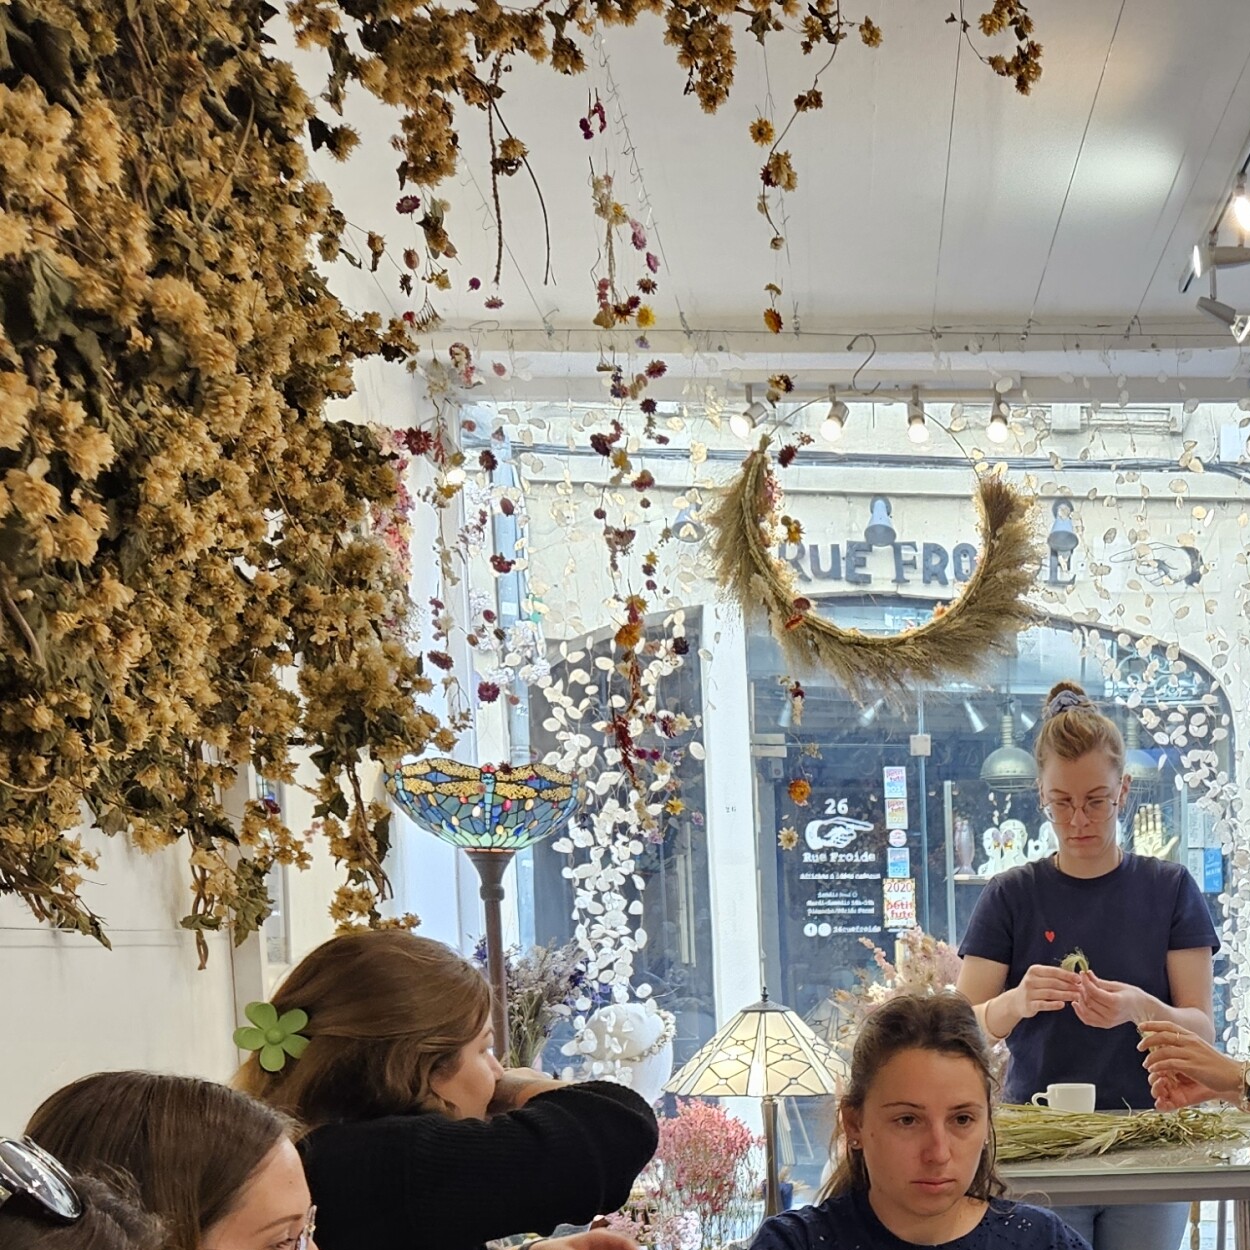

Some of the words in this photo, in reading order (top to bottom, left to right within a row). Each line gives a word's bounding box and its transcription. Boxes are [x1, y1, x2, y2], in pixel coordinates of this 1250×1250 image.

[778, 539, 871, 584] RUE
[893, 541, 1077, 586] FROE
[824, 798, 848, 814] 26
[802, 852, 827, 862] Rue
[830, 851, 876, 862] Froide
[887, 882, 913, 893] 2020
[887, 901, 913, 910] petit
